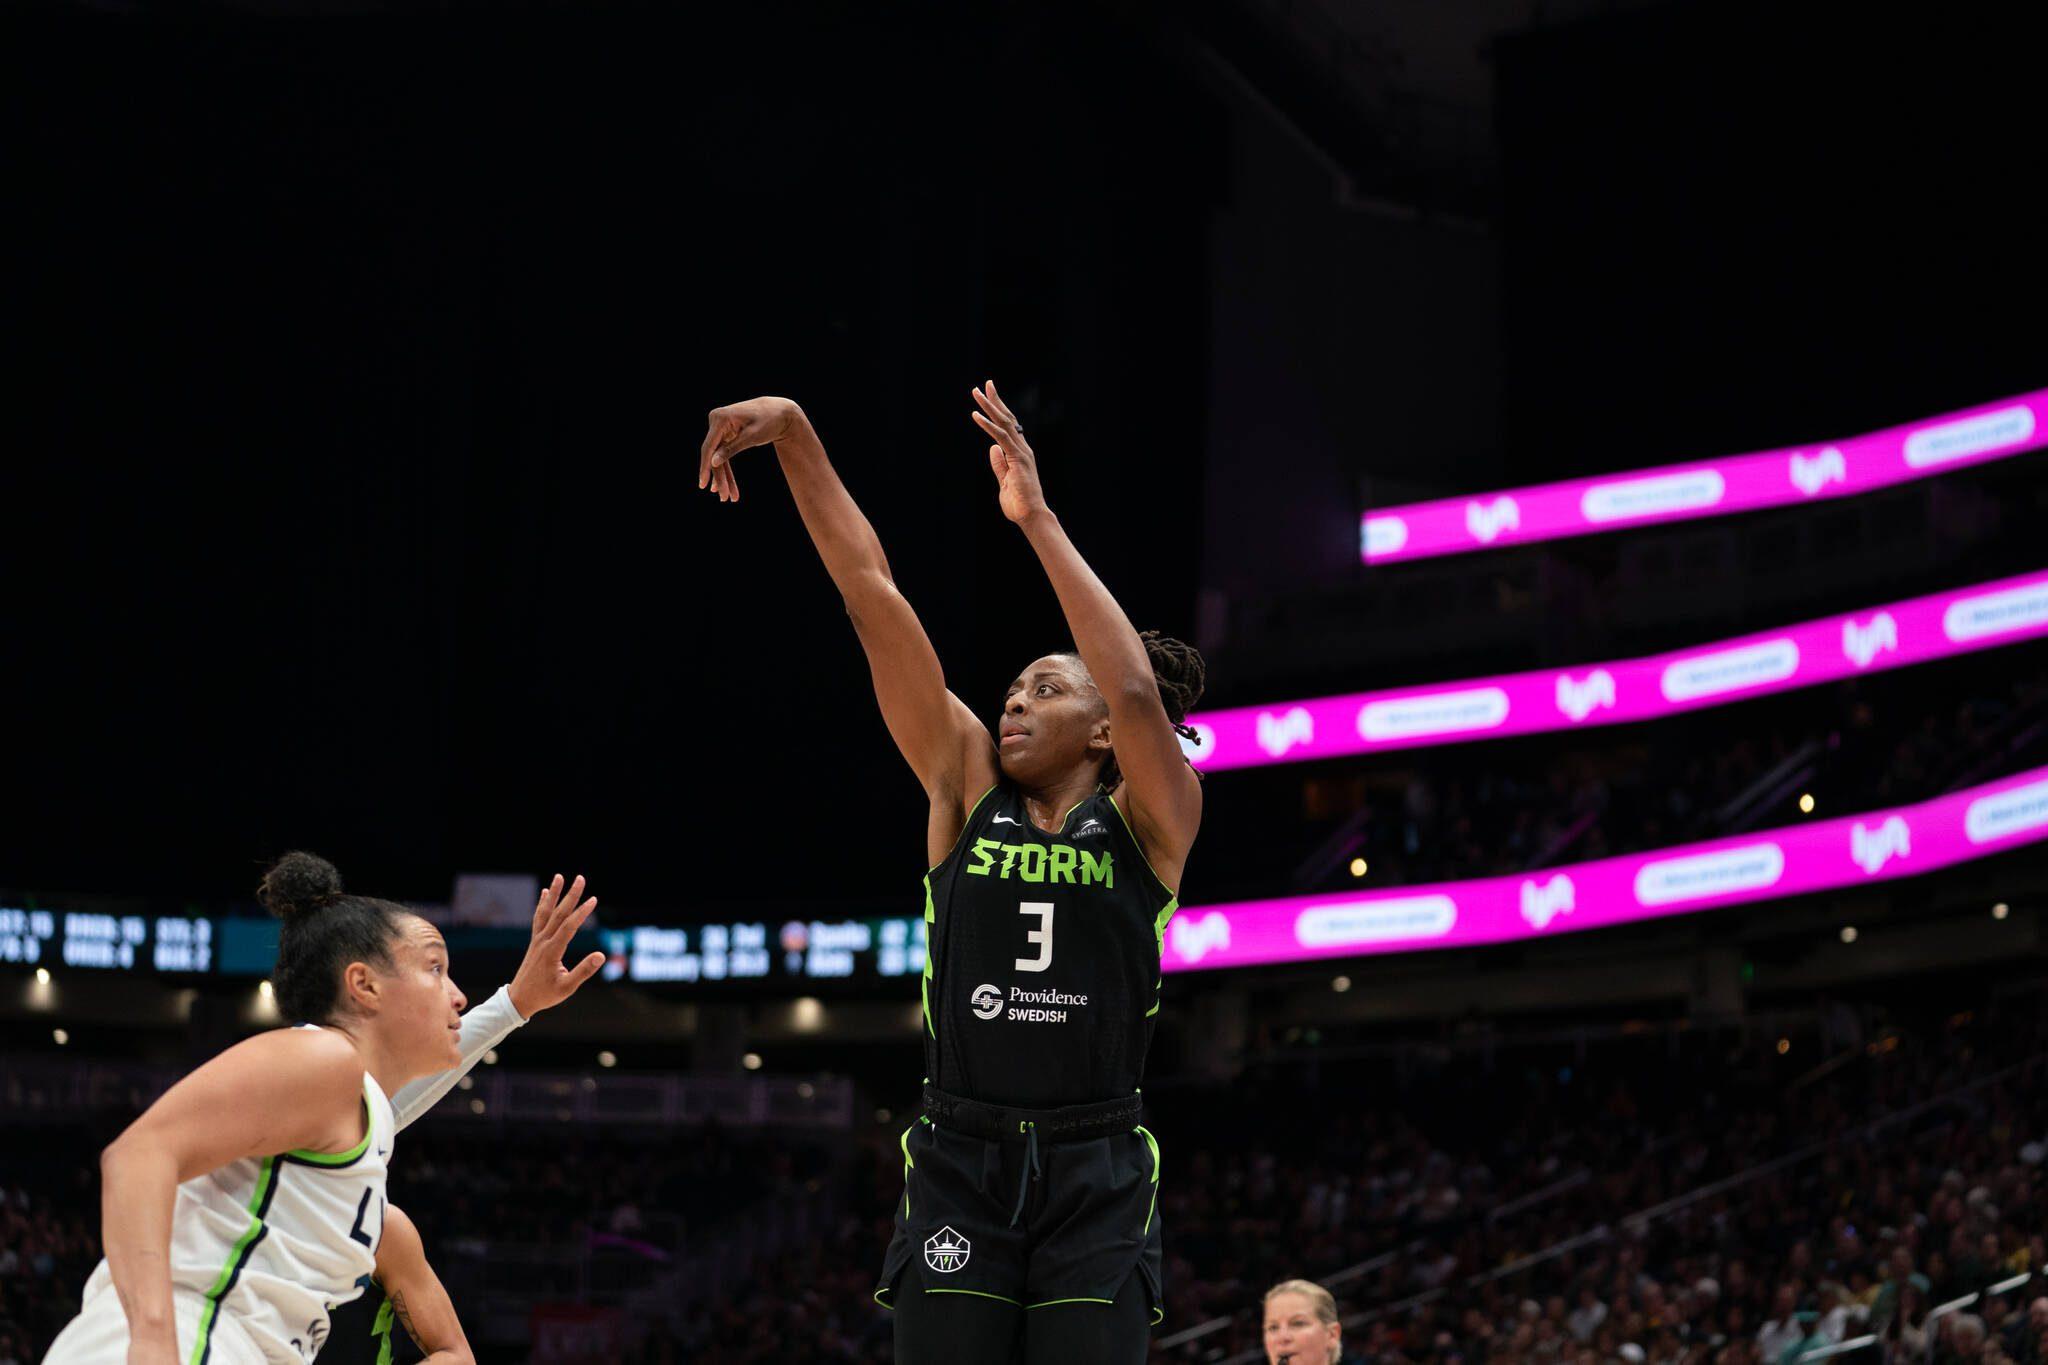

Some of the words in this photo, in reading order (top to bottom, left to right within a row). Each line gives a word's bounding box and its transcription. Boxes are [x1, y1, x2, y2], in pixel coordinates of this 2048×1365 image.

[1071, 826, 1108, 840] SYMETRA
[966, 837, 1114, 889] STORM
[1015, 902, 1055, 972] 3
[1009, 987, 1088, 1006] Providence
[1008, 1008, 1067, 1023] SWEDISH
